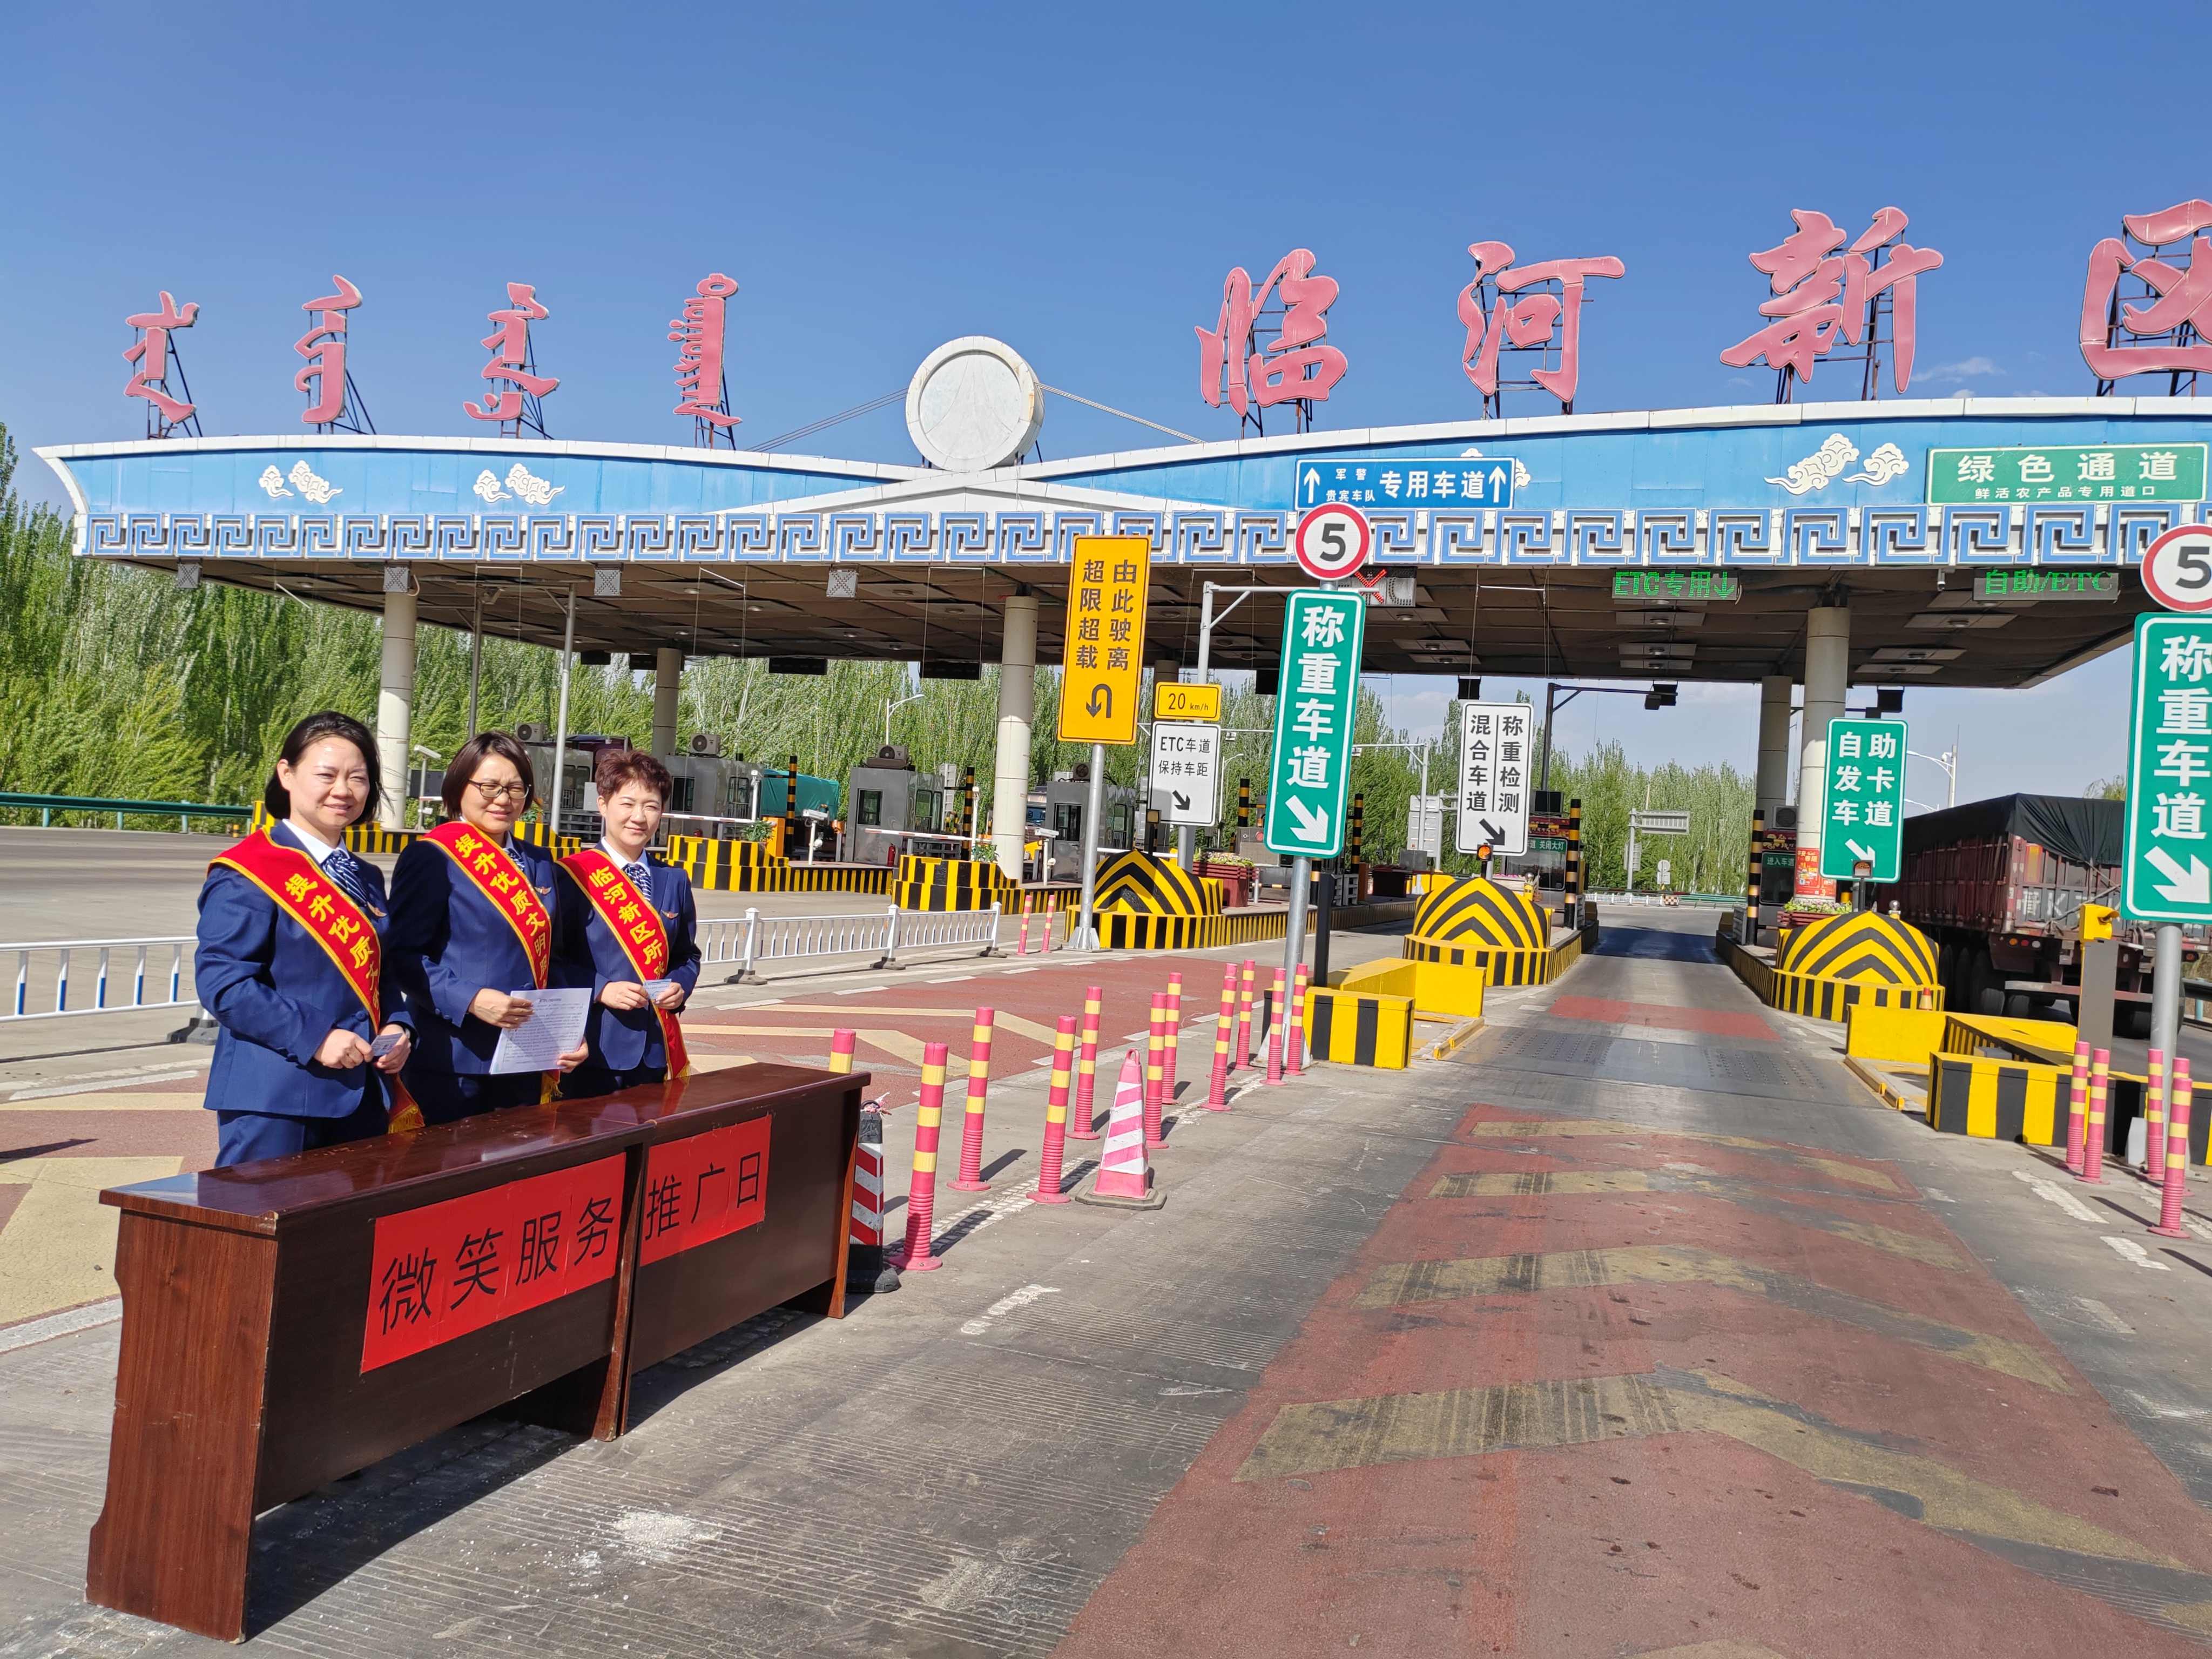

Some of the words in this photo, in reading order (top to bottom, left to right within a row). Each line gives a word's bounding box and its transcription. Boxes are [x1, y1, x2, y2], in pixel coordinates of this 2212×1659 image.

[1195, 206, 2212, 417] 临河新区
[1336, 468, 1366, 481] 军警
[1958, 451, 2177, 483] 绿色通道
[1326, 490, 1375, 502] 贵宾车队
[1379, 470, 1485, 499] 专用车道
[1975, 486, 2156, 500] 鲜活农产品专用道口
[1319, 523, 1346, 562] 5
[2175, 547, 2212, 589] 5
[1615, 570, 1711, 598] ETC专用
[1075, 559, 1104, 669] 超限超载
[1107, 559, 1137, 671] 由此驶离
[1168, 693, 1186, 710] 20
[1190, 703, 1209, 712] km/h
[1286, 606, 1345, 788] 称重车道
[1160, 737, 1210, 753] ETC车道
[1838, 731, 1897, 759] 自助
[2152, 635, 2212, 840] 称重车道
[1158, 761, 1209, 777] 保持车距
[1466, 714, 1491, 812] 混合车道
[1498, 716, 1523, 814] 称重检测
[1834, 765, 1895, 793] 发卡
[1831, 799, 1893, 827] 车道
[1539, 840, 1564, 850] 关闭大灯
[380, 1197, 615, 1335] 微笑服务
[645, 1151, 761, 1242] 推广日
